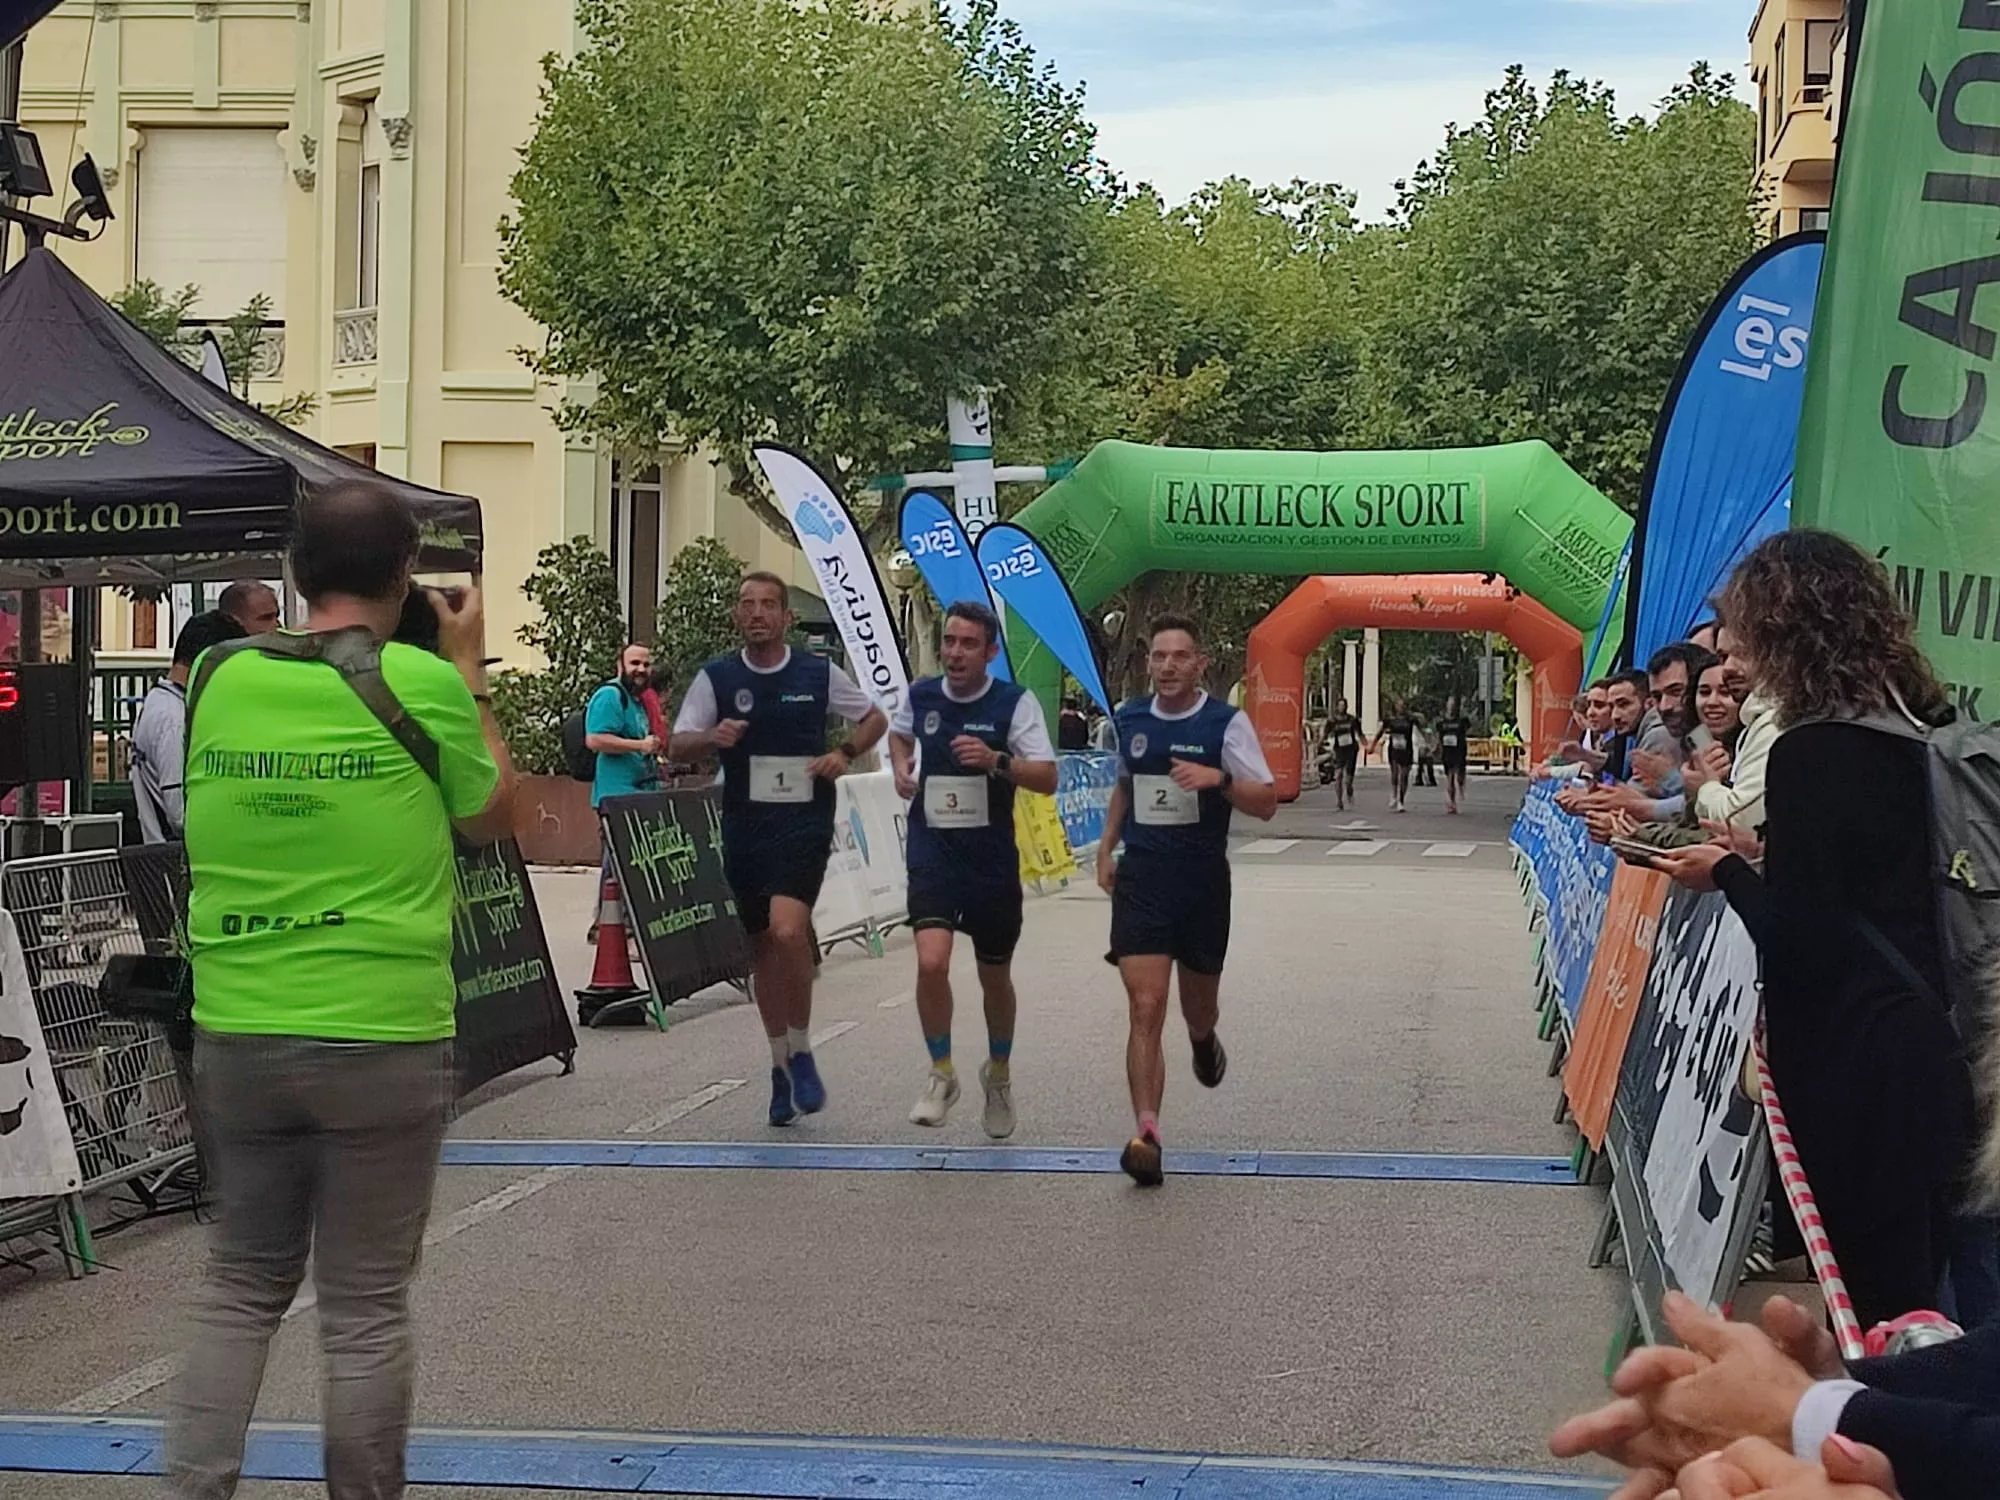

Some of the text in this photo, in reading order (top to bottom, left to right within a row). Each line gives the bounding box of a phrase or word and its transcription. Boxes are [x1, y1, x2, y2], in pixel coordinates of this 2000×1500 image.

[1726, 303, 1808, 374] es
[0, 401, 119, 441] tleck
[1165, 481, 1470, 528] FARTLECK SPORT
[1368, 534, 1388, 545] DE
[1392, 533, 1461, 545] EVENTOS
[1452, 584, 1503, 597] Huesca
[1938, 570, 2000, 642] VI
[774, 772, 784, 787] 1
[945, 793, 958, 809] 3
[1156, 789, 1168, 805] 2
